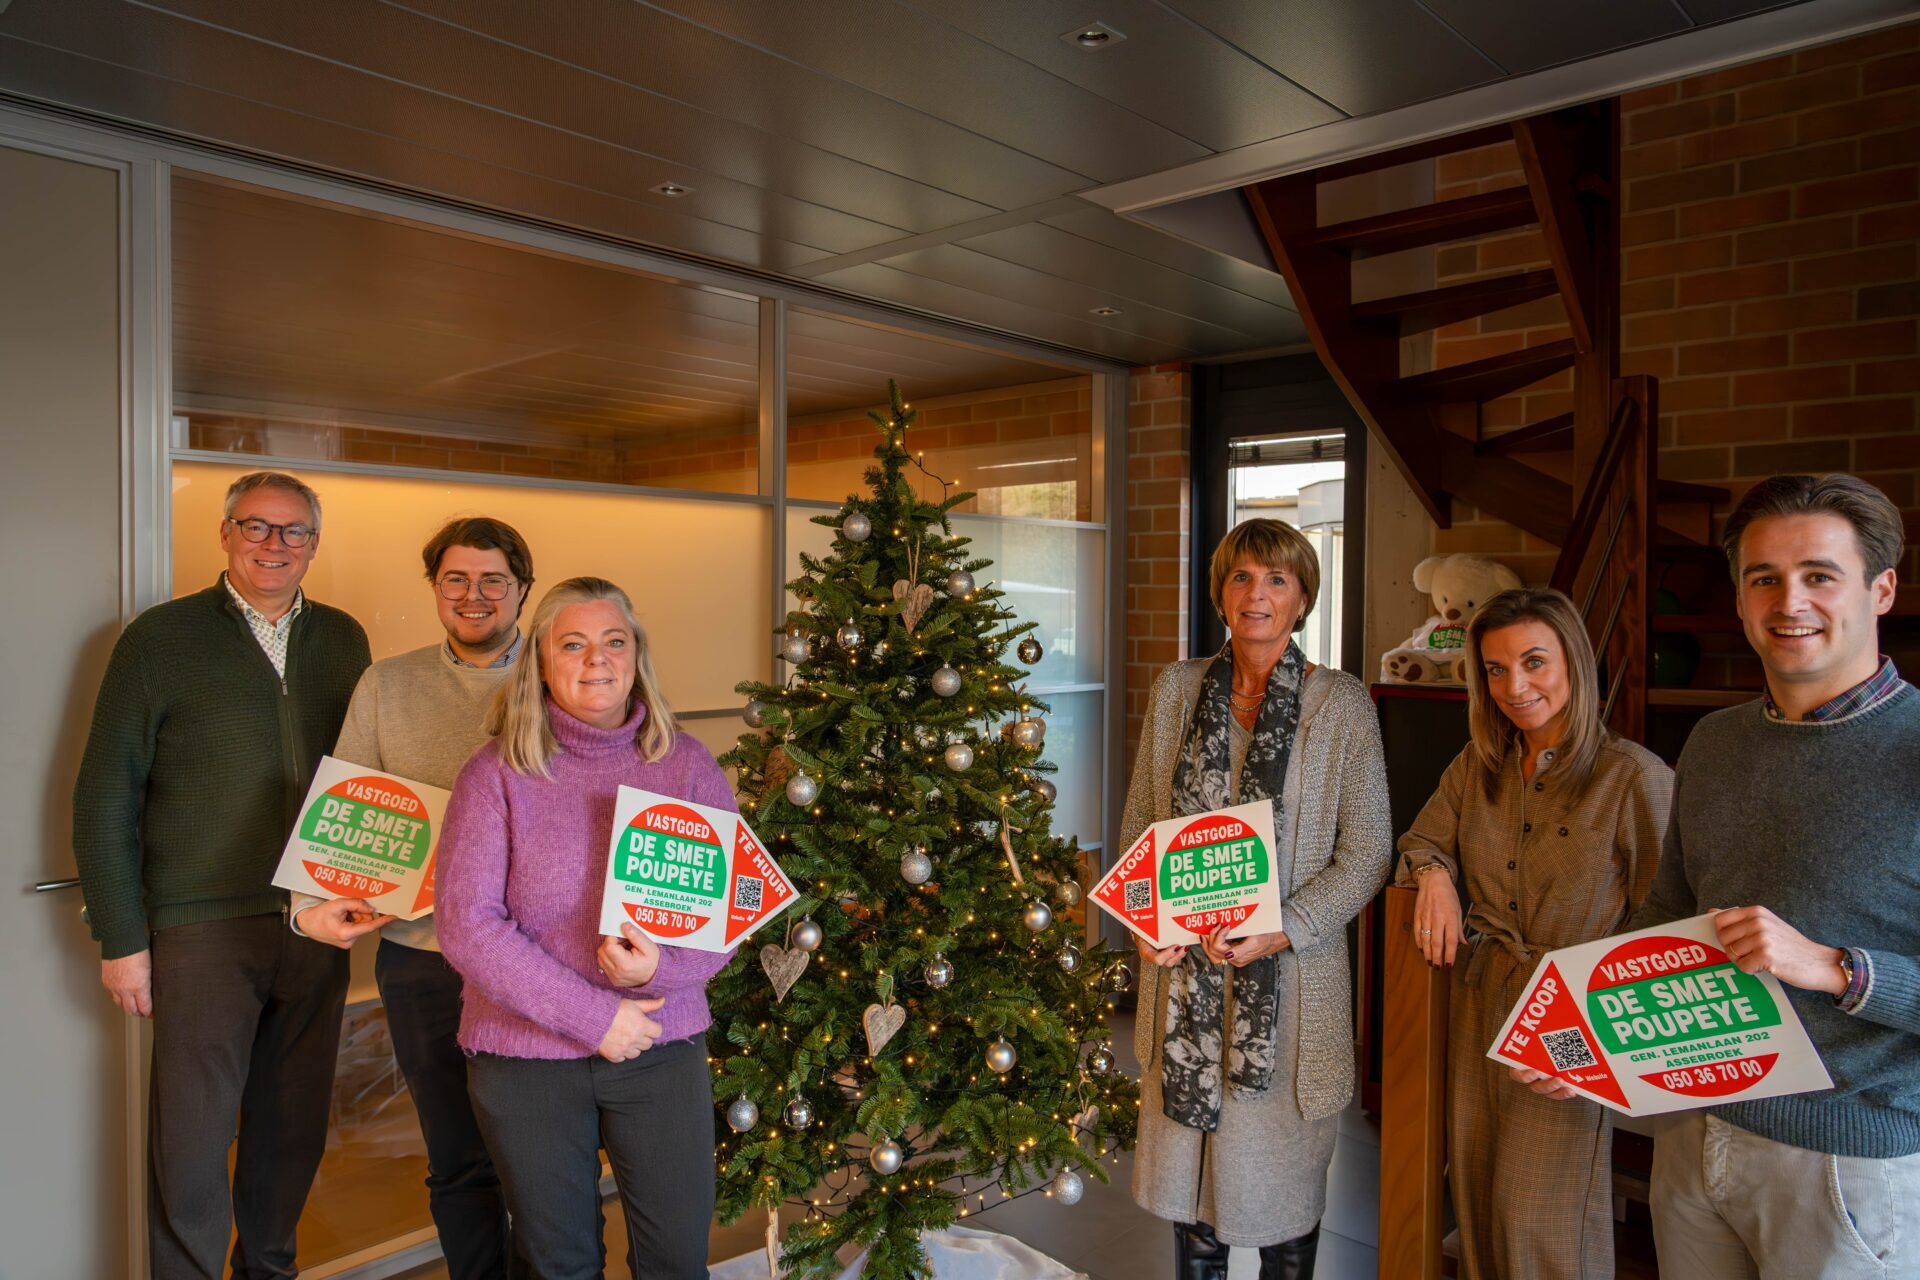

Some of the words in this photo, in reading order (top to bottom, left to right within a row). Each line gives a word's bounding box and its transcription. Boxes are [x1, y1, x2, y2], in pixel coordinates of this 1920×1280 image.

[1433, 631, 1446, 641] DE
[346, 782, 418, 813] VASTGOED
[321, 798, 355, 823] DE
[360, 809, 423, 841] SMET
[646, 812, 710, 839] VASTGOED
[1179, 823, 1243, 846] VASTGOED
[313, 819, 415, 861] POUPEYE
[629, 832, 656, 857] DE
[664, 839, 718, 869] SMET
[308, 845, 329, 856] GEN.
[333, 851, 387, 870] LEMANLAAN
[390, 866, 406, 875] 202
[326, 859, 381, 877] ASSEBROEK
[737, 831, 755, 856] TE
[752, 852, 787, 898] HUUR
[1099, 880, 1119, 897] TE
[1117, 840, 1151, 881] KOOP
[1170, 852, 1194, 873] DE
[1203, 840, 1255, 867] SMET
[314, 867, 335, 881] 050
[337, 873, 351, 886] 36
[355, 878, 368, 890] 70
[369, 882, 383, 894] 00
[626, 855, 715, 891] POUPEYE
[1170, 862, 1257, 893] POUPEYE
[625, 884, 644, 894] GEN.
[647, 889, 696, 904] LEMANLAAN
[644, 898, 692, 912] ASSEBROEK
[1173, 899, 1191, 907] GEN.
[1193, 890, 1241, 904] LEMANLAAN
[1244, 887, 1258, 895] 202
[1192, 900, 1239, 912] ASSEBROEK
[635, 908, 653, 922] 050
[656, 911, 668, 925] 36
[671, 914, 683, 928] 70
[685, 916, 697, 930] 00
[1185, 914, 1203, 928] 050
[1205, 912, 1217, 925] 36
[1220, 910, 1231, 923] 70
[1234, 908, 1245, 921] 00
[1600, 944, 1707, 983] VASTGOED
[1597, 988, 1645, 1019] DE
[1649, 968, 1739, 1009] SMET
[1504, 1030, 1531, 1056] TE
[1519, 977, 1560, 1031] KOOP
[1611, 996, 1760, 1046] POUPEYE
[1630, 1050, 1660, 1063] GEN.
[1662, 1036, 1742, 1057] LEMANLAAN
[1745, 1031, 1770, 1042] 202
[1666, 1048, 1744, 1068] ASSEBROEK
[1585, 1072, 1608, 1081] Website
[1662, 1069, 1693, 1090] 050
[1697, 1065, 1716, 1083] 36
[1720, 1063, 1739, 1080] 70
[1742, 1059, 1763, 1077] 00
